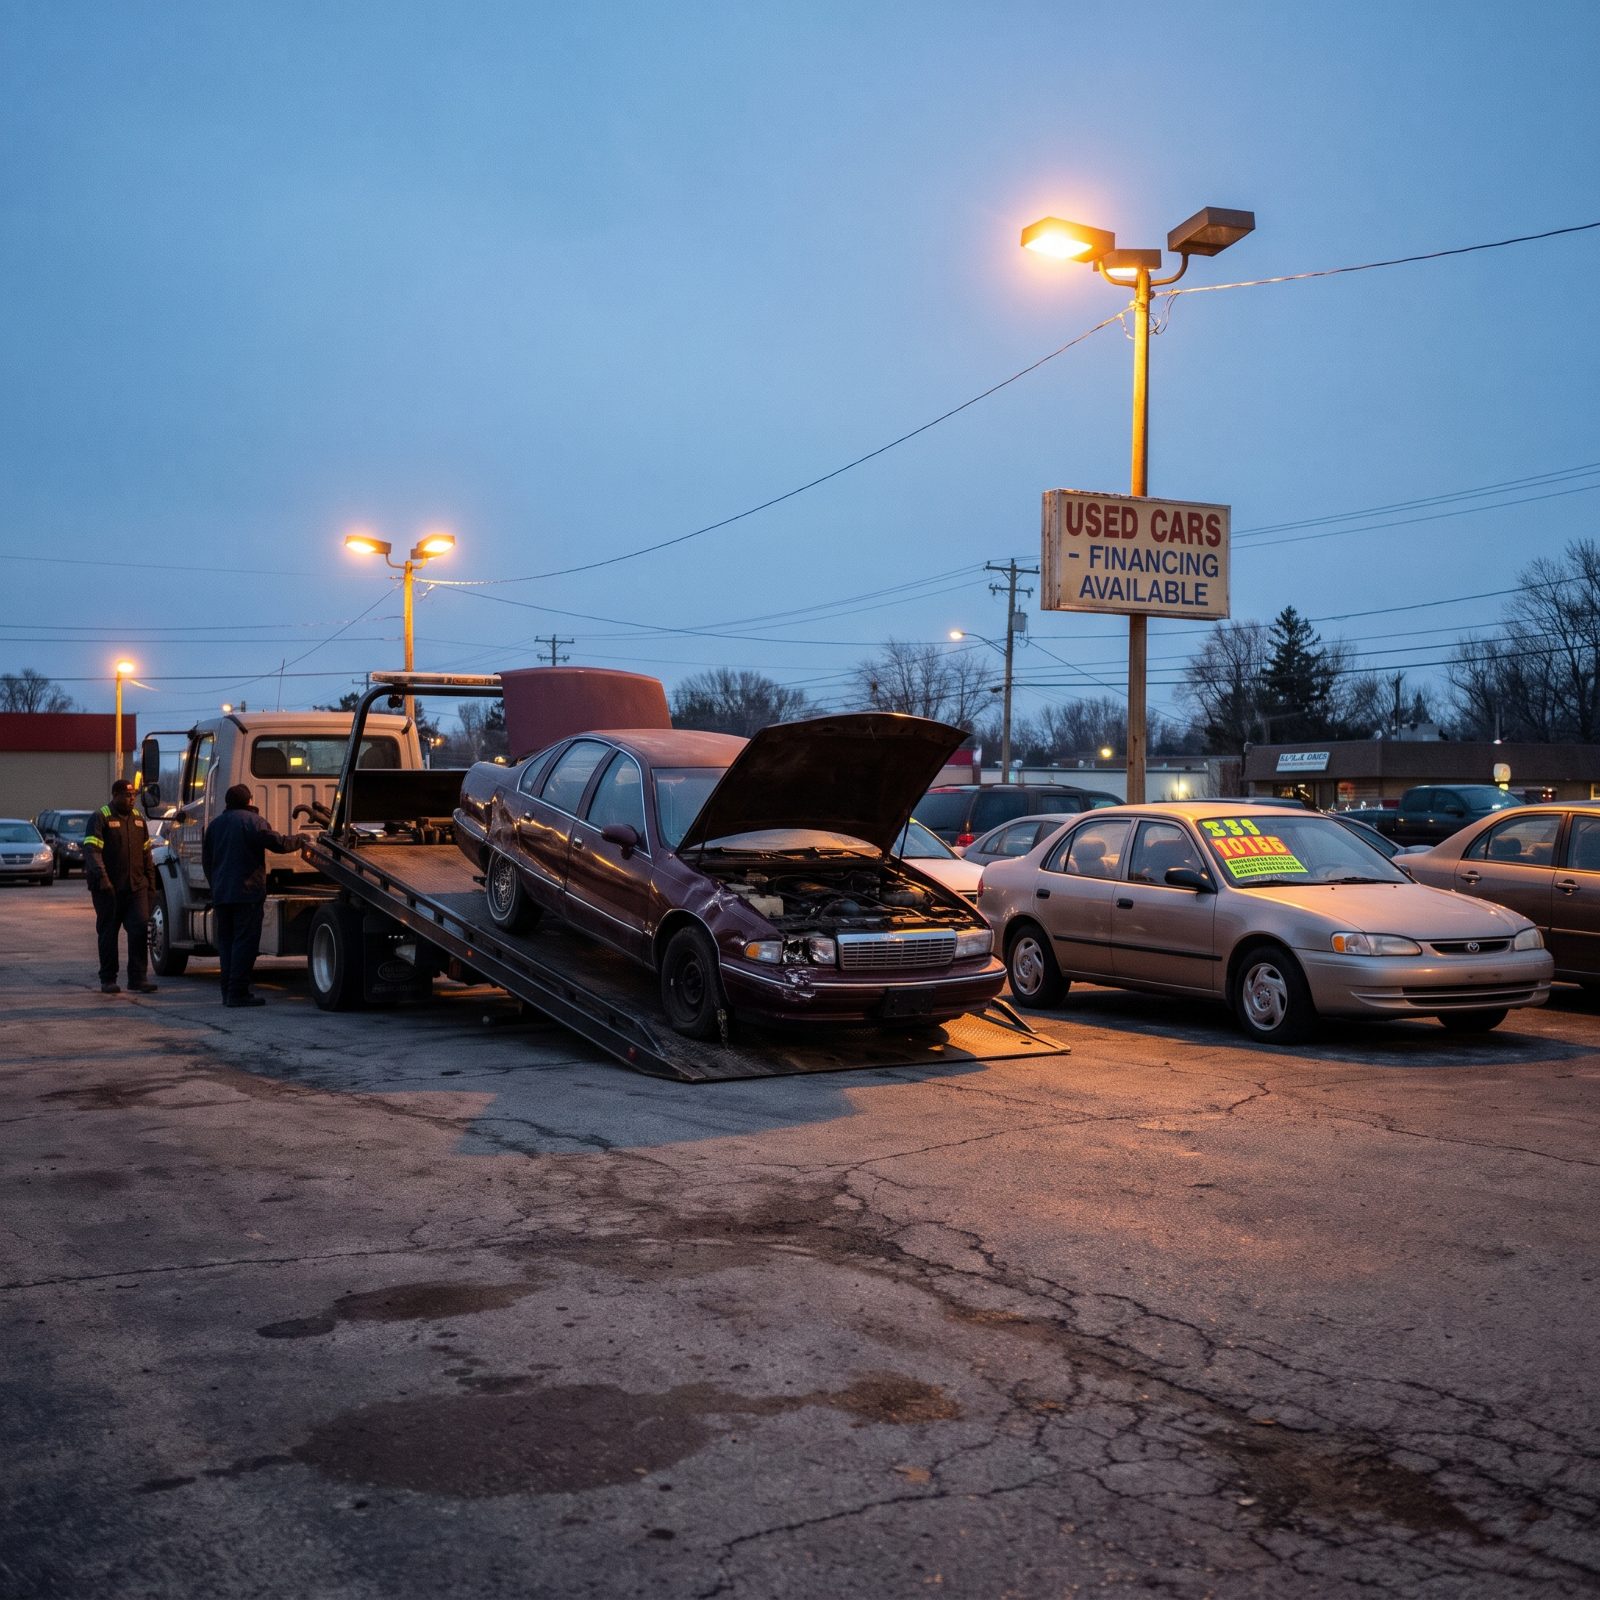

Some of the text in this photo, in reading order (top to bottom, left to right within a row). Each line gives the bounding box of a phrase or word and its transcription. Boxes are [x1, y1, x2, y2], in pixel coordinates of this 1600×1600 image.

[1066, 501, 1222, 547] USED CARS
[1089, 545, 1219, 578] FINANCING
[1079, 575, 1209, 606] AVAILABLE
